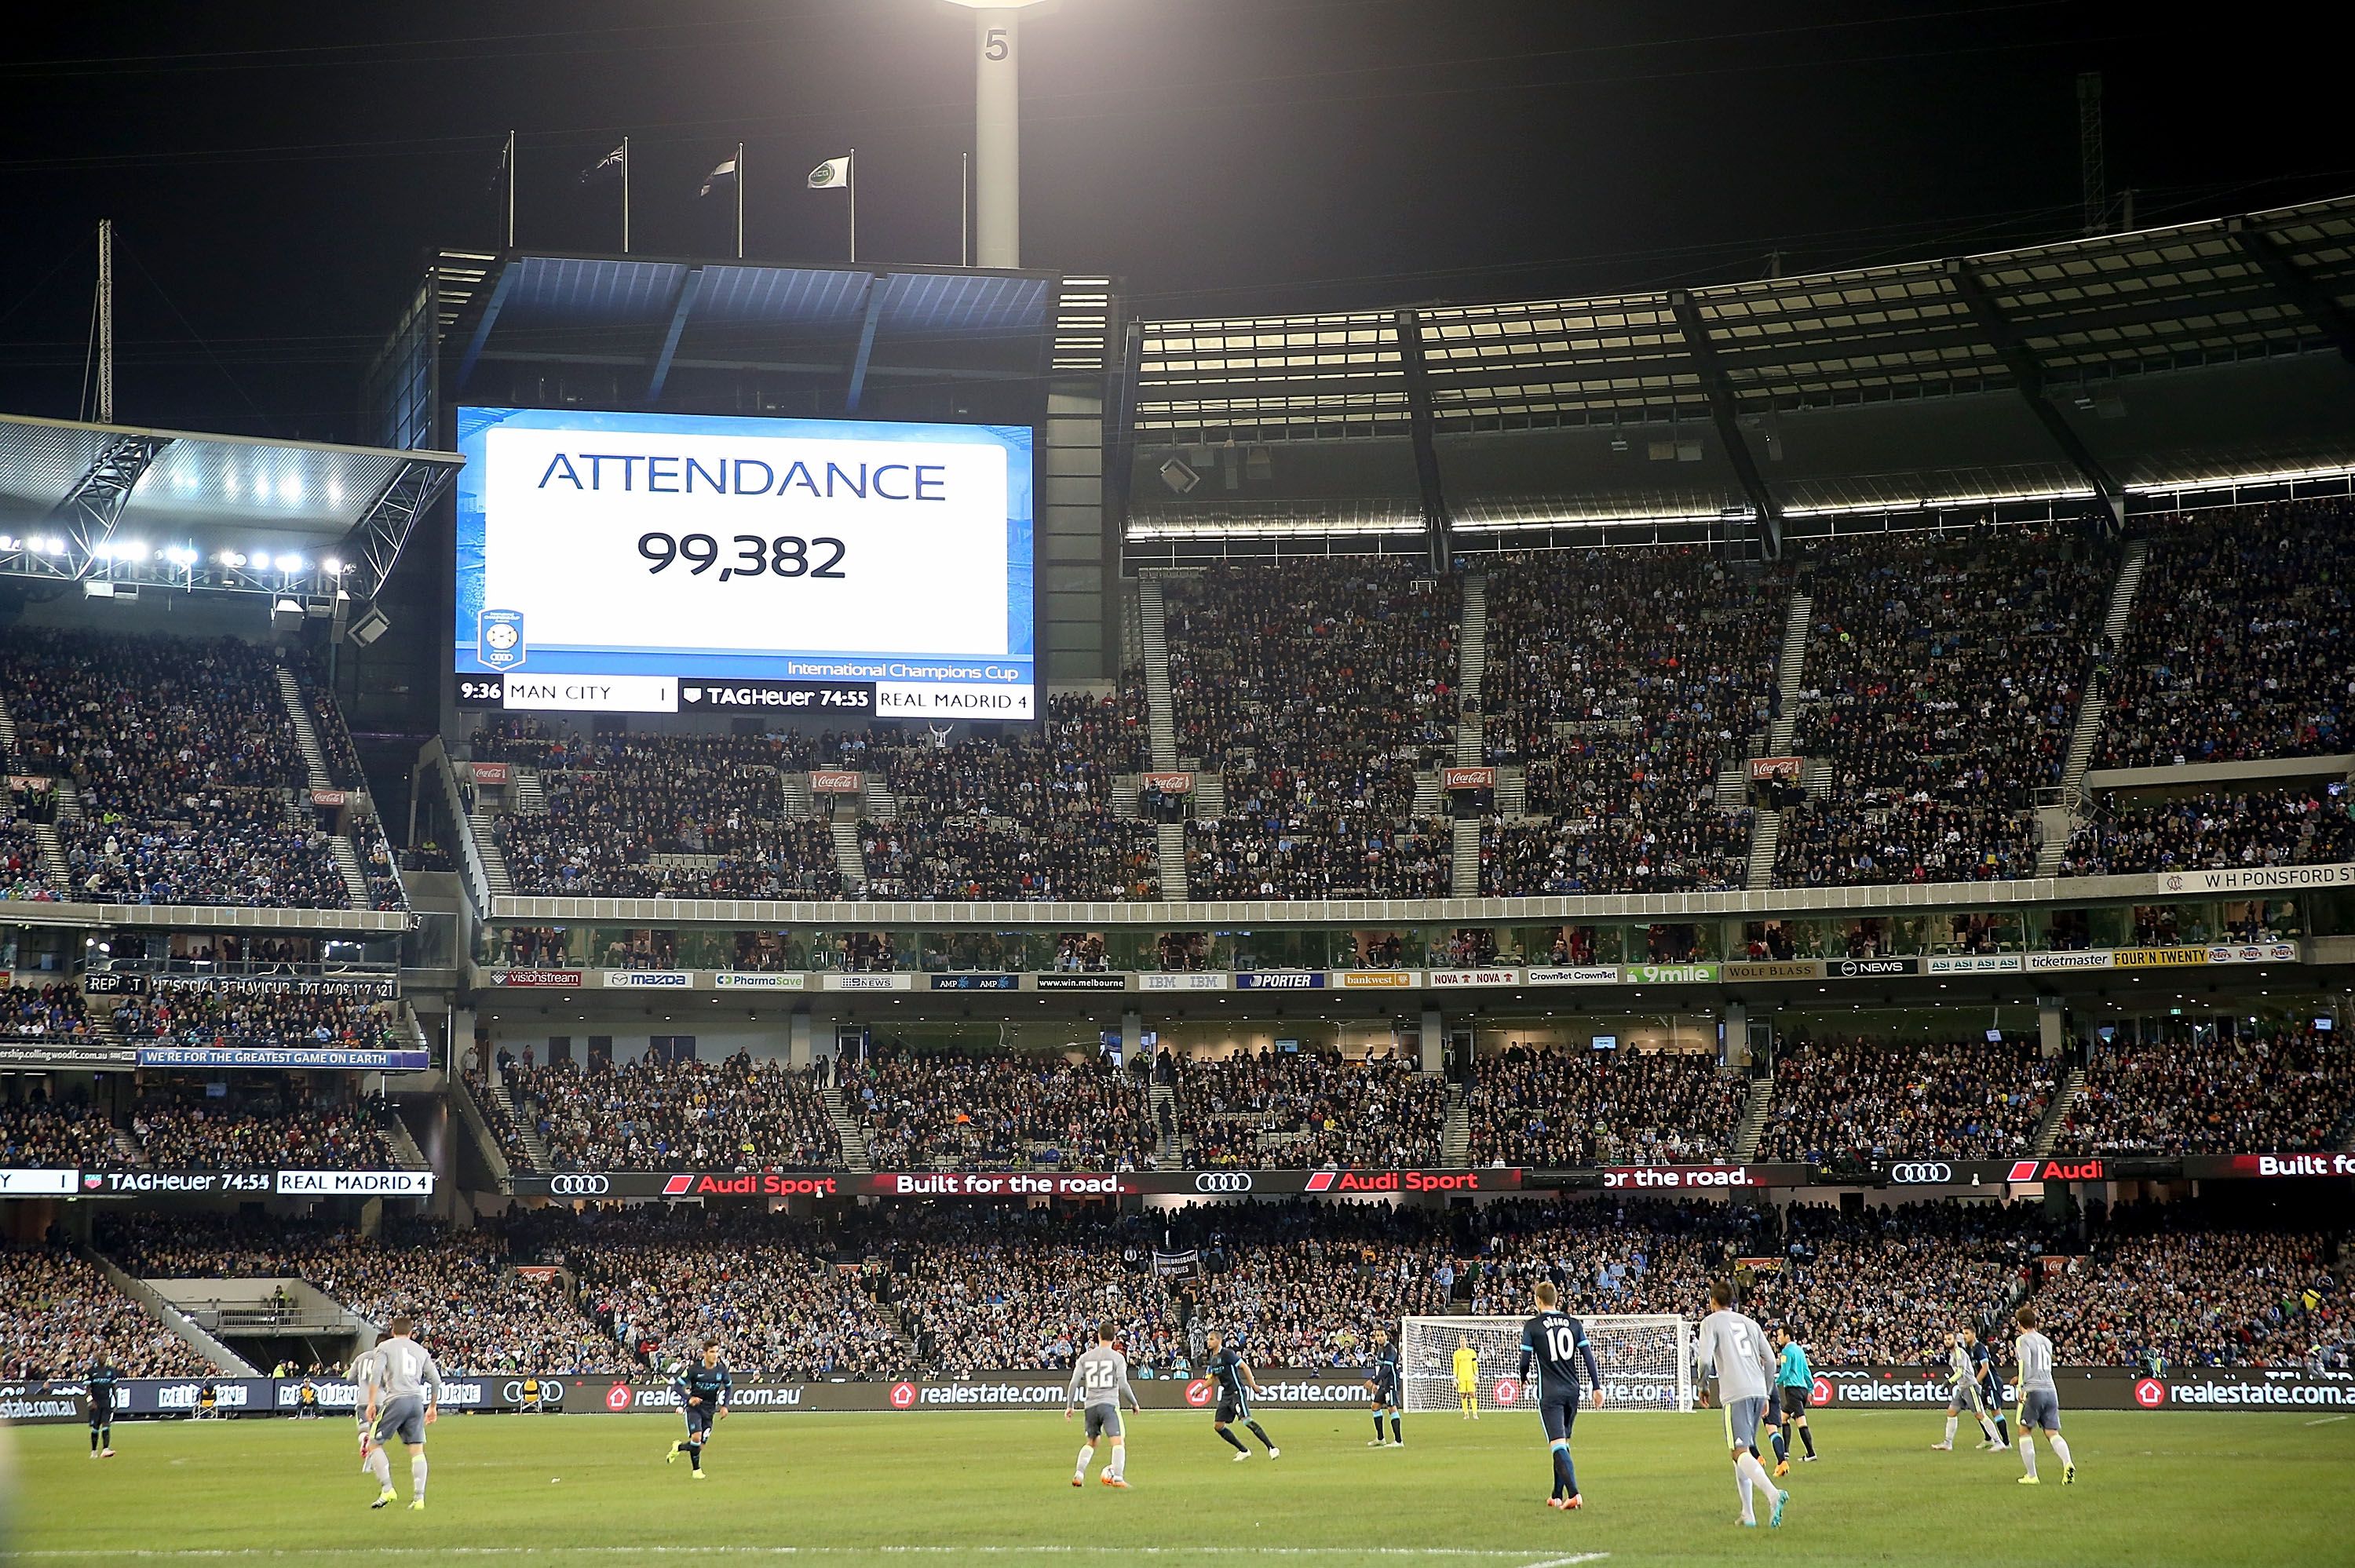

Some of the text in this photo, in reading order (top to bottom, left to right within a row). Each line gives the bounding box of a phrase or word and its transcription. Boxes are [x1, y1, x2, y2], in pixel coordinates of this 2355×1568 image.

[985, 29, 1009, 61] 5
[539, 453, 946, 501] ATTENDANCE
[637, 532, 846, 582] 99,382
[787, 661, 1019, 683] International Champions Cup
[461, 682, 502, 699] 9:36
[511, 685, 556, 698] MAN
[565, 687, 611, 700] CITY
[820, 688, 869, 707] 74:55
[881, 692, 1027, 709] REAL MADRID 4
[2205, 874, 2221, 888] W
[2226, 873, 2236, 887] H
[2243, 868, 2335, 886] PONSFORD
[2114, 950, 2206, 965] FOUR'N TWENTY
[2208, 950, 2232, 960] Peters
[2239, 949, 2262, 958] Peters
[2270, 947, 2294, 957] Peters
[1860, 961, 1903, 972] NEWS
[1932, 960, 1950, 968] ASI
[1954, 959, 1972, 968] ASI
[2032, 954, 2108, 968] ticketmaster
[1434, 973, 1500, 984] NOVA NOVA
[1530, 970, 1616, 981] CrownBet CrownBet
[1729, 966, 1812, 977] WOLF BLASS
[734, 975, 802, 986] PharmaSave
[1039, 979, 1123, 987] www.win.melbourne
[1148, 975, 1218, 988] IBM IBM
[1261, 975, 1312, 987] PORTER
[1347, 975, 1393, 984] bankwest
[147, 1052, 182, 1062] WE'RE
[184, 1052, 207, 1063] FOR
[210, 1052, 232, 1063] THE
[235, 1053, 292, 1064] GREATEST
[294, 1053, 327, 1064] GAME
[329, 1054, 347, 1064] ON
[349, 1054, 387, 1065] EARTH
[2043, 1160, 2102, 1180] Audi
[2258, 1155, 2328, 1176] Built
[0, 1174, 13, 1188] Y
[282, 1176, 427, 1190] REAL MADRID 4
[896, 1174, 1126, 1194] Built for the road.
[1338, 1172, 1478, 1192] Audi Sport
[1634, 1168, 1679, 1187] the
[1685, 1166, 1754, 1186] road.
[697, 1175, 837, 1196] Audi Sport
[1170, 1253, 1196, 1265] BRISBANE
[1546, 1327, 1574, 1363] 10
[1729, 1322, 1753, 1357] 2
[402, 1347, 417, 1377] 6
[1085, 1359, 1114, 1388] 22
[160, 1385, 246, 1406] MELBRNE
